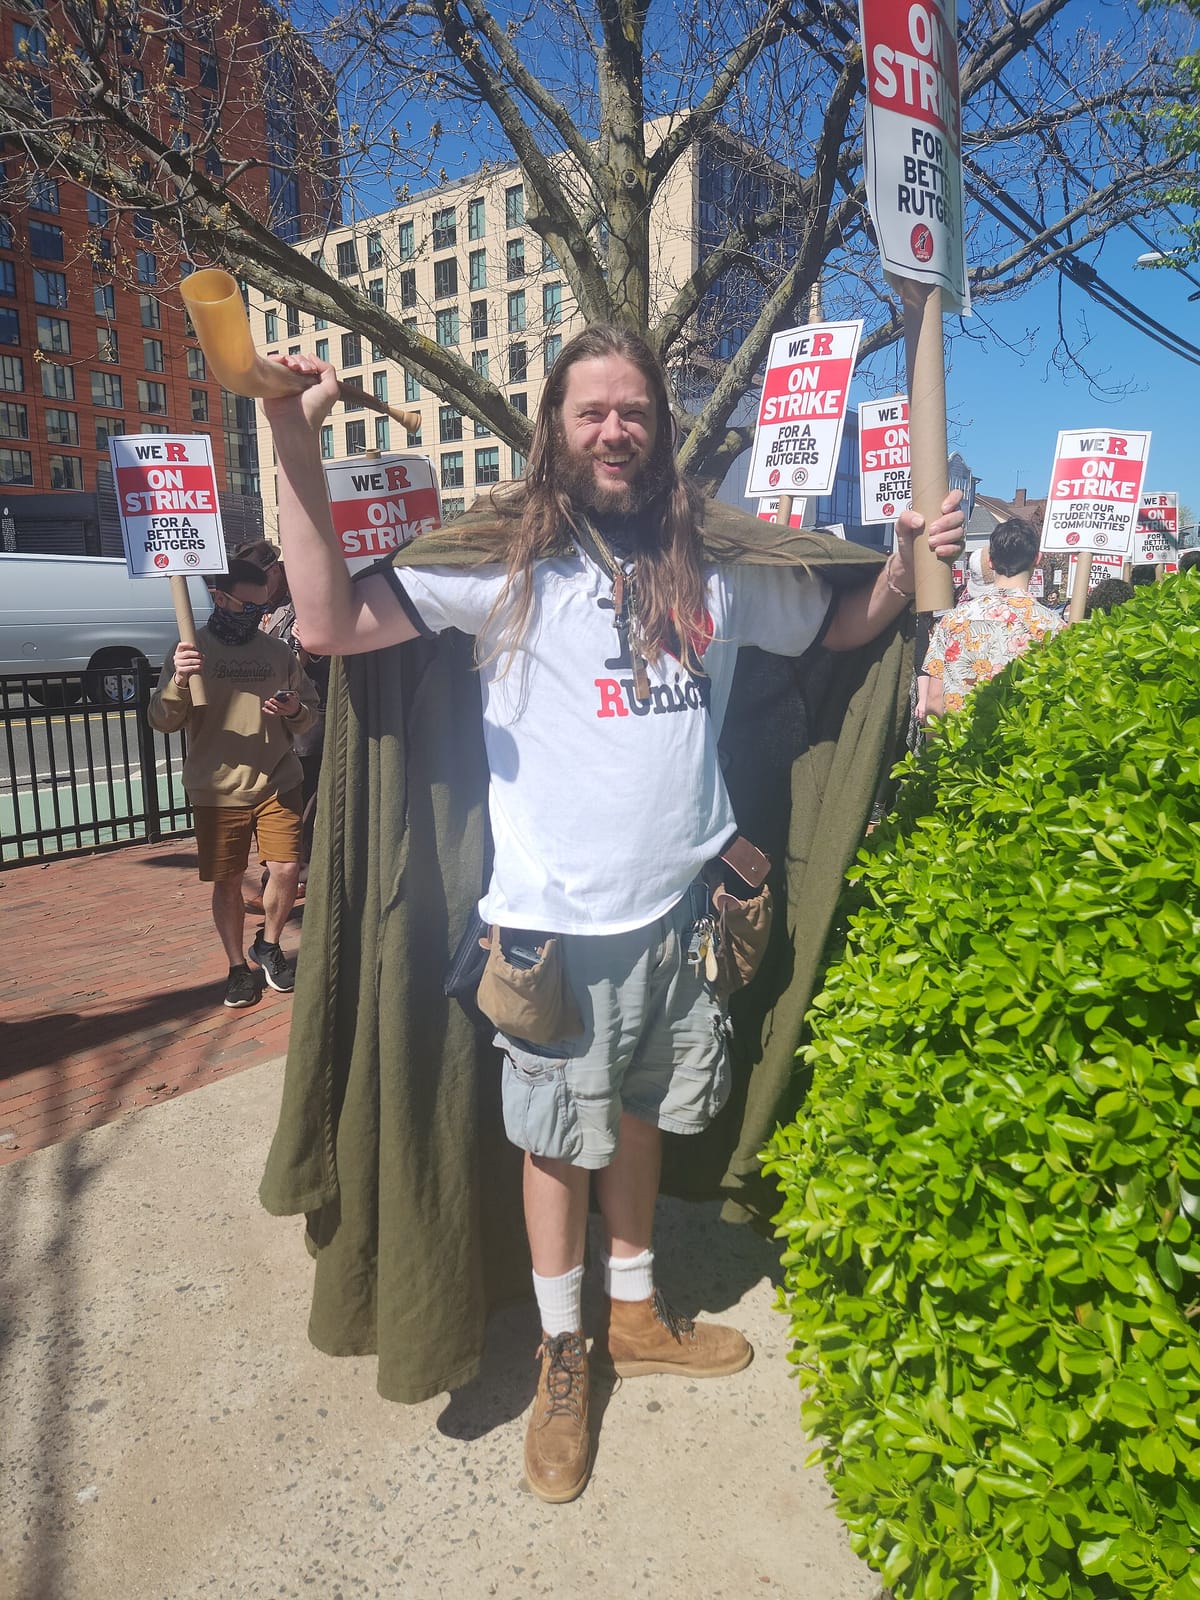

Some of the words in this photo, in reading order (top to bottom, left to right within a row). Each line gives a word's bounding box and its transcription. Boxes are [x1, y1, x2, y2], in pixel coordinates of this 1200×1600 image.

[908, 3, 945, 71] ON
[912, 127, 943, 166] FOR
[788, 339, 810, 358] WE
[810, 333, 834, 357] R
[787, 366, 820, 392] ON
[763, 389, 842, 420] STRIKE
[878, 407, 899, 421] WE
[778, 425, 800, 439] FOR
[802, 424, 811, 437] A
[135, 446, 162, 460] WE
[165, 442, 189, 462] R
[771, 438, 817, 453] BETTER
[1080, 439, 1105, 452] WE
[1107, 436, 1128, 456] R
[765, 452, 820, 468] RUTGERS
[865, 446, 911, 468] STRI
[884, 471, 905, 482] FOR
[1082, 460, 1115, 479] ON
[147, 469, 184, 490] ON
[351, 473, 384, 492] WE
[385, 465, 411, 491] R
[879, 480, 912, 492] BETTE
[876, 489, 912, 502] RUTGE
[1056, 479, 1136, 499] STRIKE
[125, 490, 212, 512] STRIKE
[1070, 503, 1090, 512] FOR
[1092, 503, 1114, 513] OUR
[1144, 497, 1158, 505] WE
[1158, 496, 1168, 506] R
[367, 499, 407, 526] ON
[1051, 512, 1106, 521] STUDENTS
[1107, 514, 1130, 523] AND
[1148, 509, 1165, 519] ON
[151, 518, 178, 529] FOR
[182, 517, 191, 528] A
[1054, 520, 1125, 532] COMMUNITIES
[1136, 520, 1175, 531] STRIKE
[147, 529, 199, 541] BETTER
[342, 517, 435, 553] STRIKE
[144, 540, 205, 552] RUTGERS
